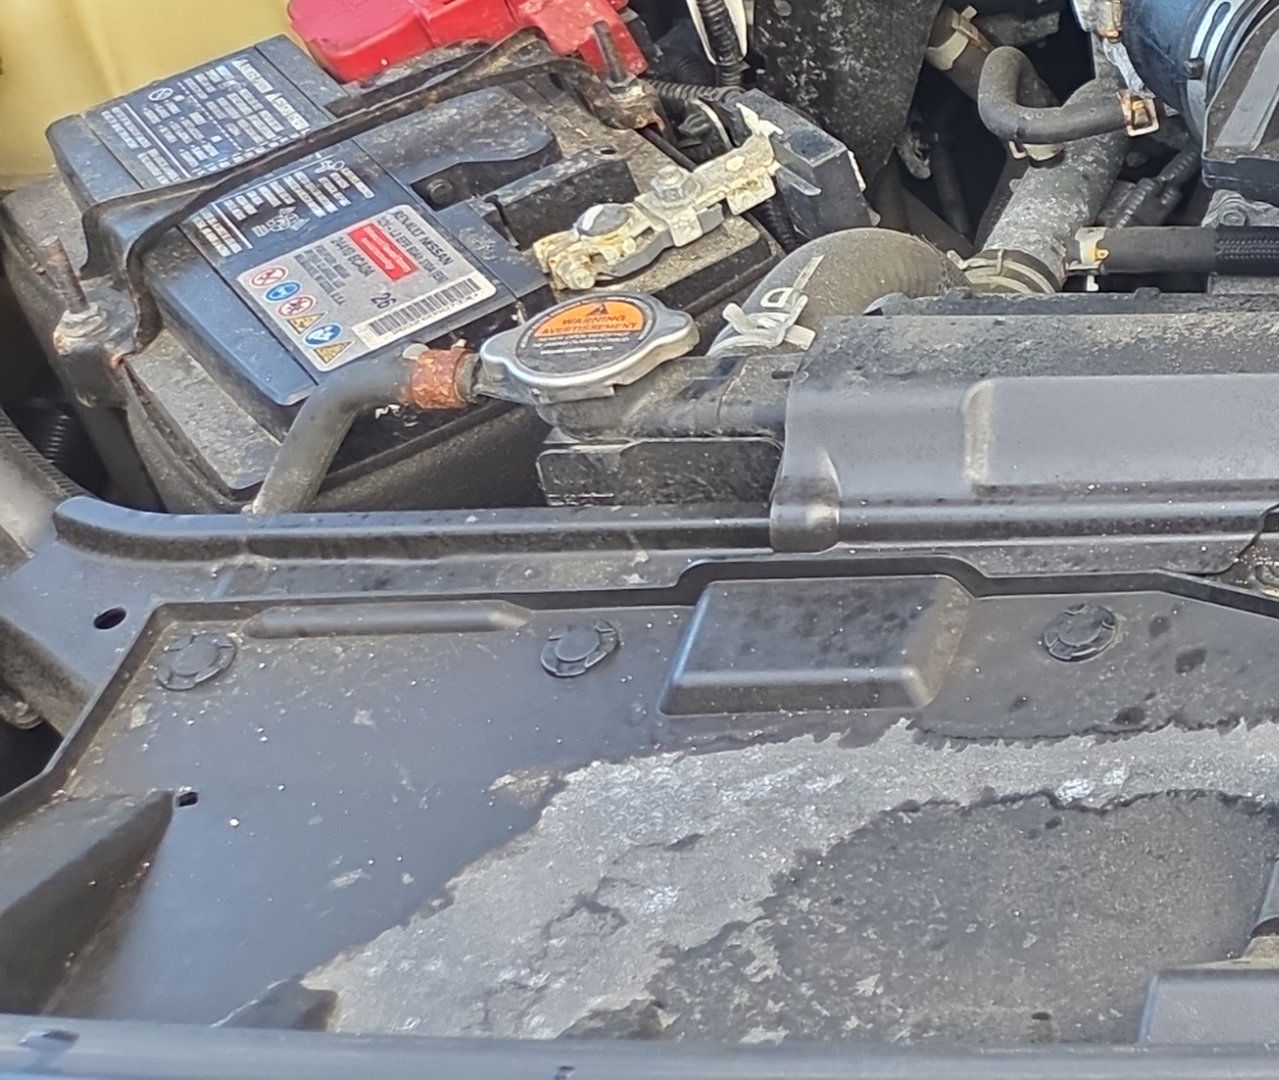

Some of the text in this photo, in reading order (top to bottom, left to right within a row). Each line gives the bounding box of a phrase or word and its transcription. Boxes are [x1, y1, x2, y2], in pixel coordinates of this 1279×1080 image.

[419, 236, 454, 266] NISSAN
[370, 292, 397, 310] 26
[563, 316, 625, 325] WARNING
